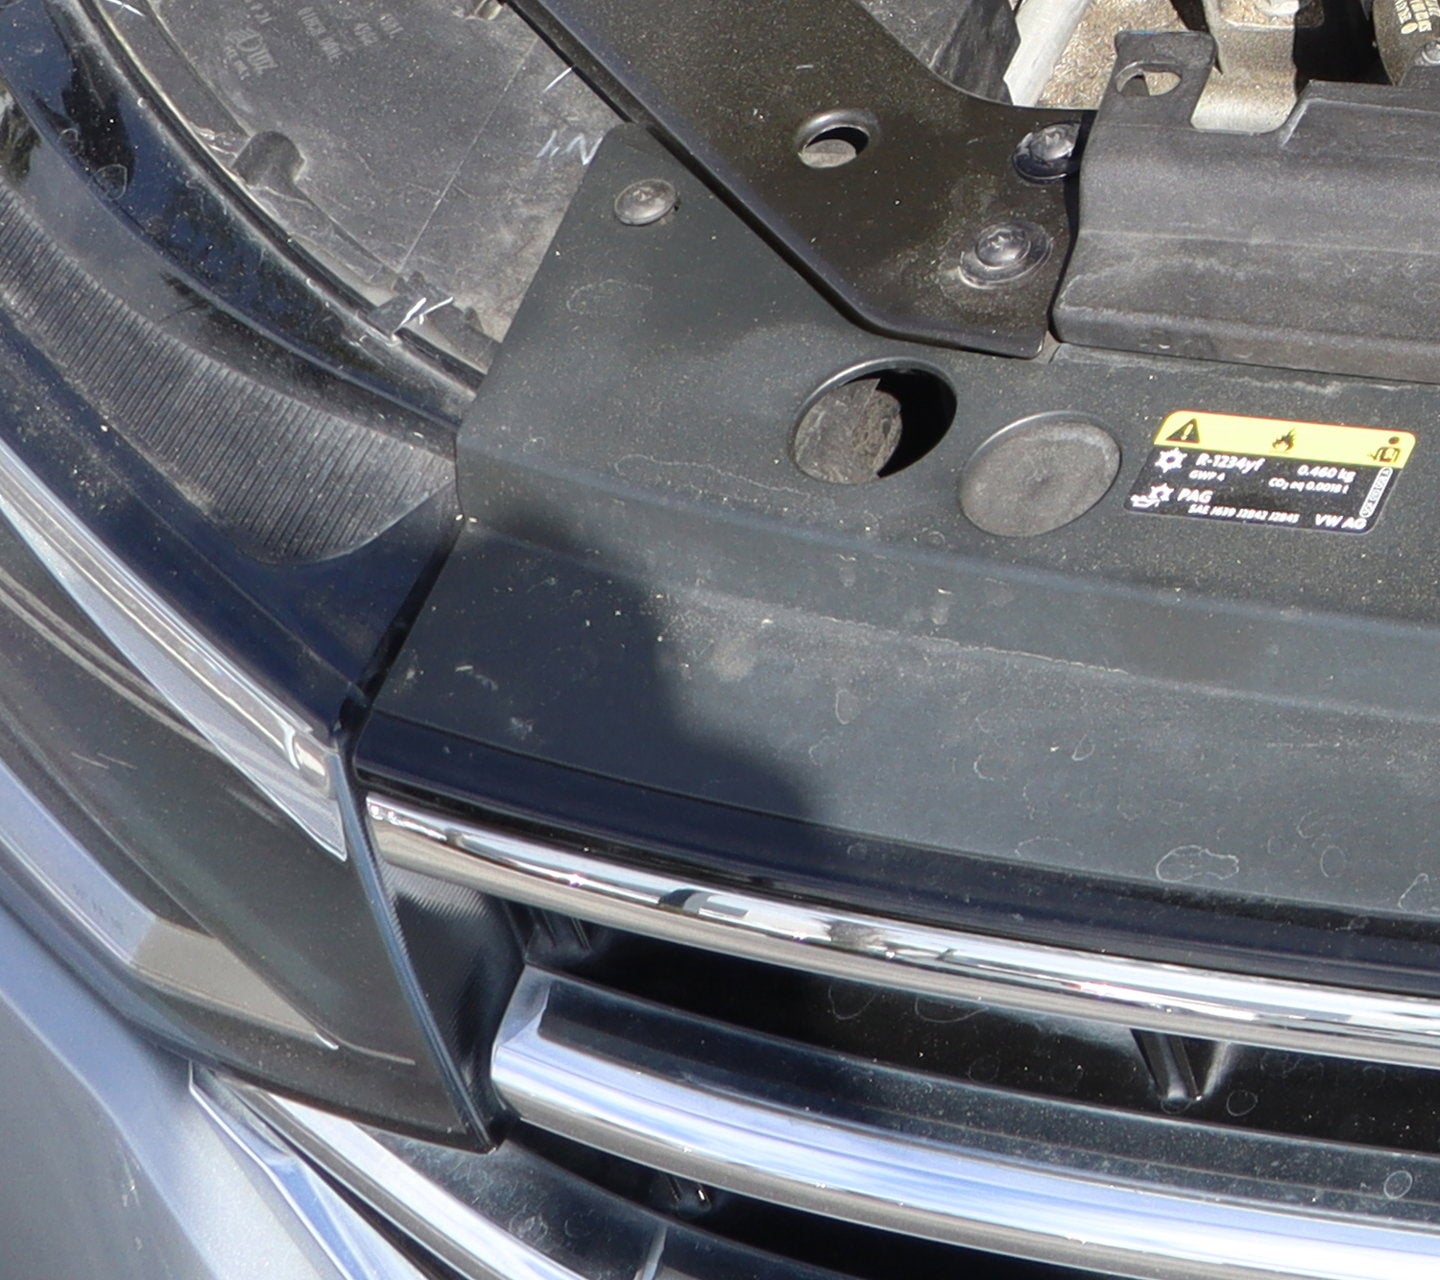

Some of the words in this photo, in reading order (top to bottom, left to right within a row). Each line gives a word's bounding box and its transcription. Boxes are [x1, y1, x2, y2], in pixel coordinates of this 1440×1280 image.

[1195, 453, 1266, 474] R-1234yf
[1338, 468, 1356, 483] kg
[1177, 488, 1214, 504] PAG
[1314, 514, 1341, 527] VW
[1342, 516, 1368, 530] AG
